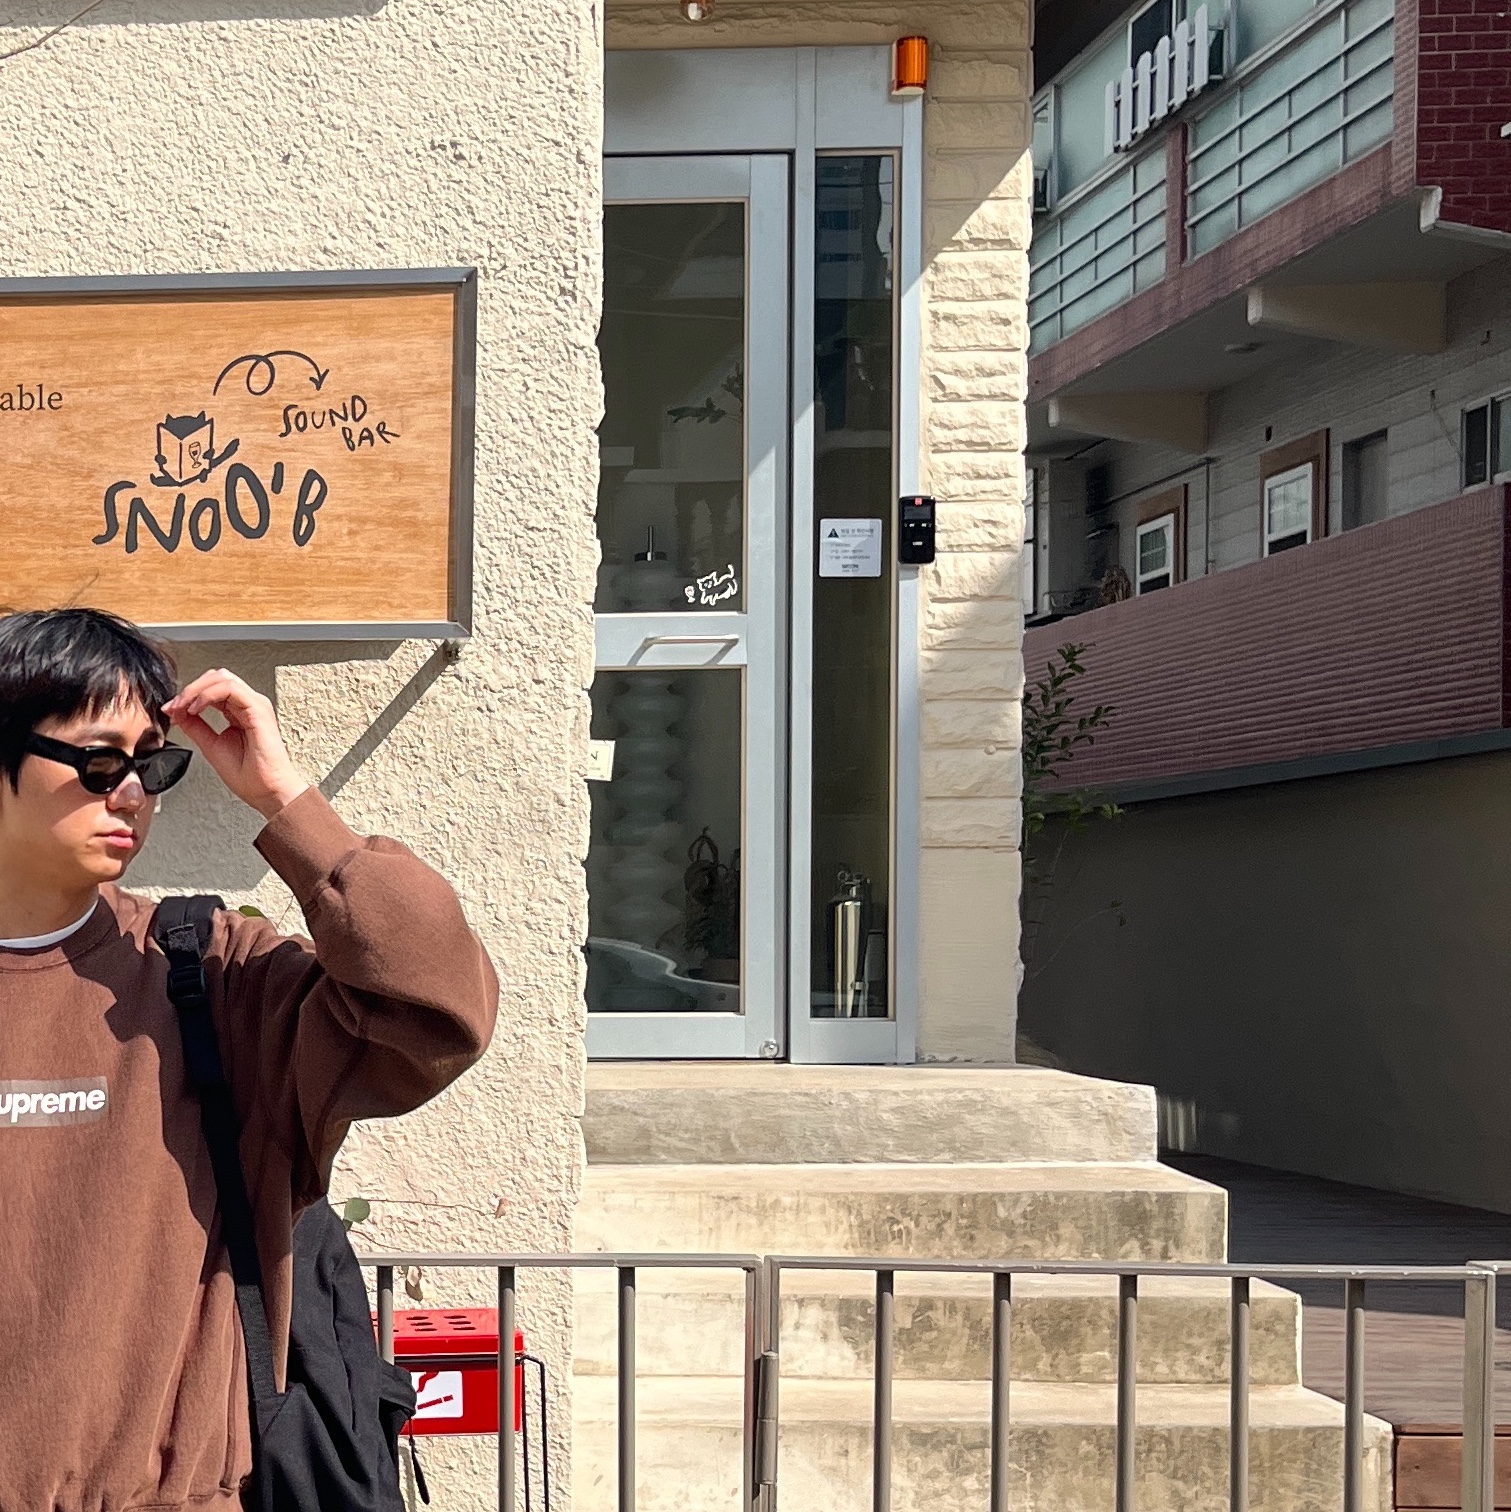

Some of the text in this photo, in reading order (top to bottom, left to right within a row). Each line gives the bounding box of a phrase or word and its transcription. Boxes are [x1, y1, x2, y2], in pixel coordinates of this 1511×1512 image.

[279, 394, 367, 438] SOUND
[341, 420, 400, 452] BAR
[92, 462, 328, 553] SNOO'B
